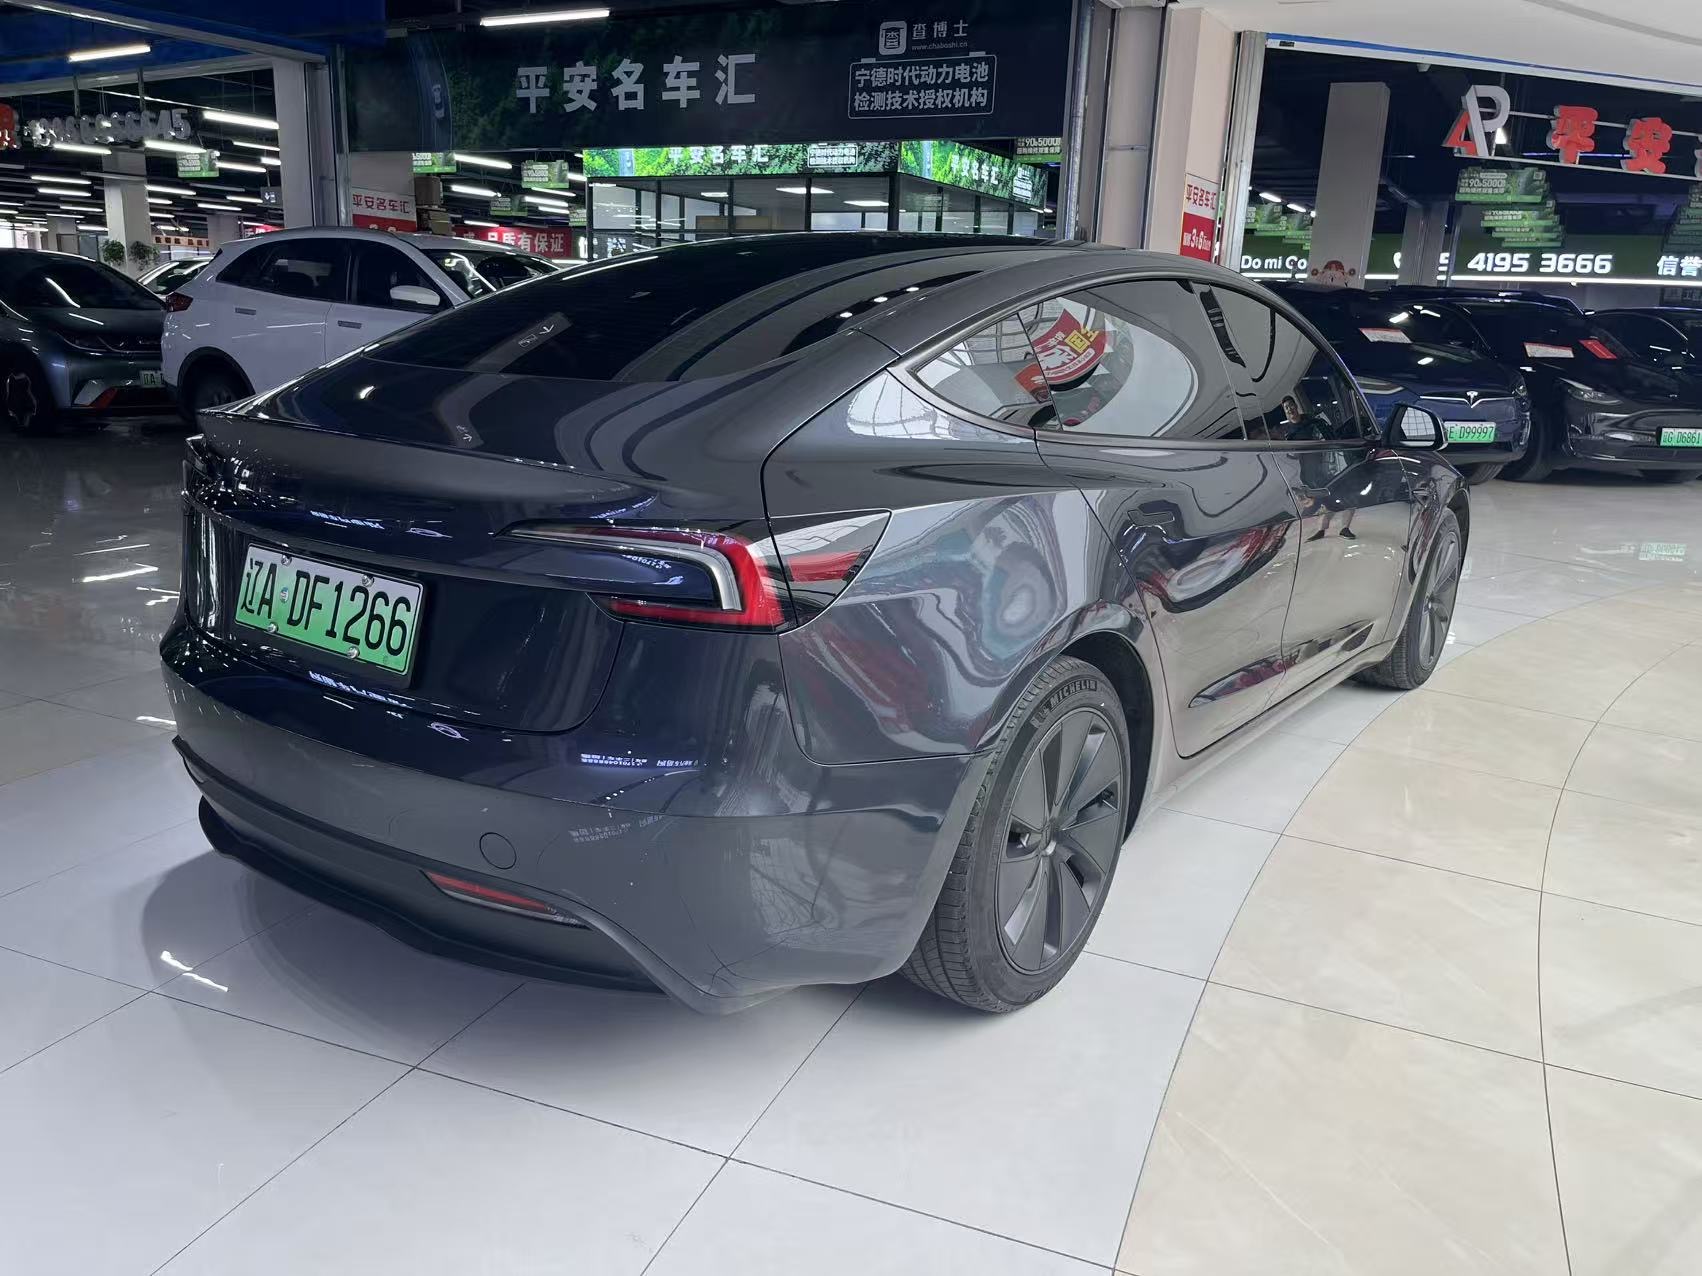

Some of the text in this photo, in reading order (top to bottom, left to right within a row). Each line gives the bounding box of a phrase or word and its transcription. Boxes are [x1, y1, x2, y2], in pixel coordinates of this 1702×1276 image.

[912, 20, 969, 40] 查博士
[911, 41, 968, 51] www.chaboshi.cn
[516, 54, 756, 114] 平安名车汇
[855, 62, 989, 88] 宁德时代动力电池
[854, 87, 988, 111] 检测技术授权机构
[668, 145, 769, 164] 平安名车汇
[352, 193, 410, 215] 平安名车汇
[1240, 255, 1261, 270] Do
[1264, 255, 1283, 270] mi
[1467, 252, 1531, 273] 4195
[1539, 253, 1613, 274] 3666
[1050, 679, 1098, 709] MICHELIN
